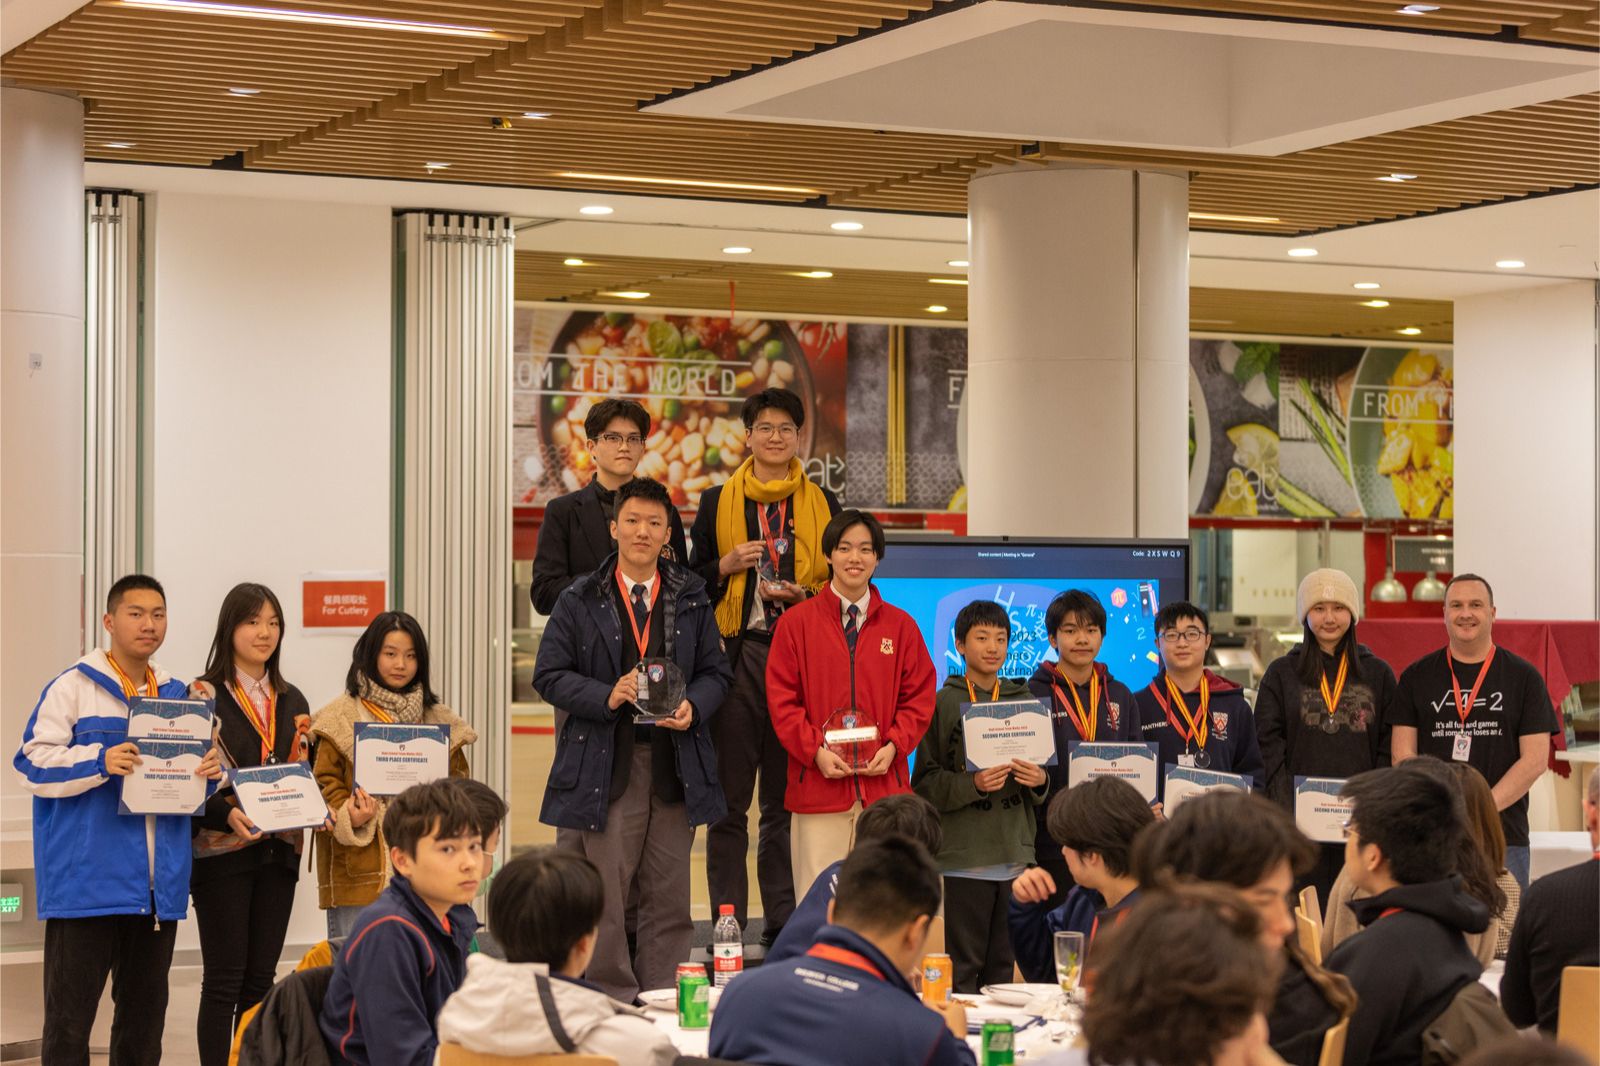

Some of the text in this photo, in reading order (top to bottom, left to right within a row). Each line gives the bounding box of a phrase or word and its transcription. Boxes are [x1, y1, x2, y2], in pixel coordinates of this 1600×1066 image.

[516, 360, 736, 395] OM THE WORLD
[1363, 391, 1420, 417] FROM
[322, 605, 369, 617] For Cutlery
[1011, 632, 1037, 642] 2023
[1006, 652, 1029, 660] ners
[997, 666, 1036, 676] nternat
[1141, 721, 1168, 731] PANTHERS
[1435, 721, 1445, 729] It's
[1466, 720, 1477, 728] and
[1478, 721, 1499, 730] games
[1431, 730, 1444, 738] until
